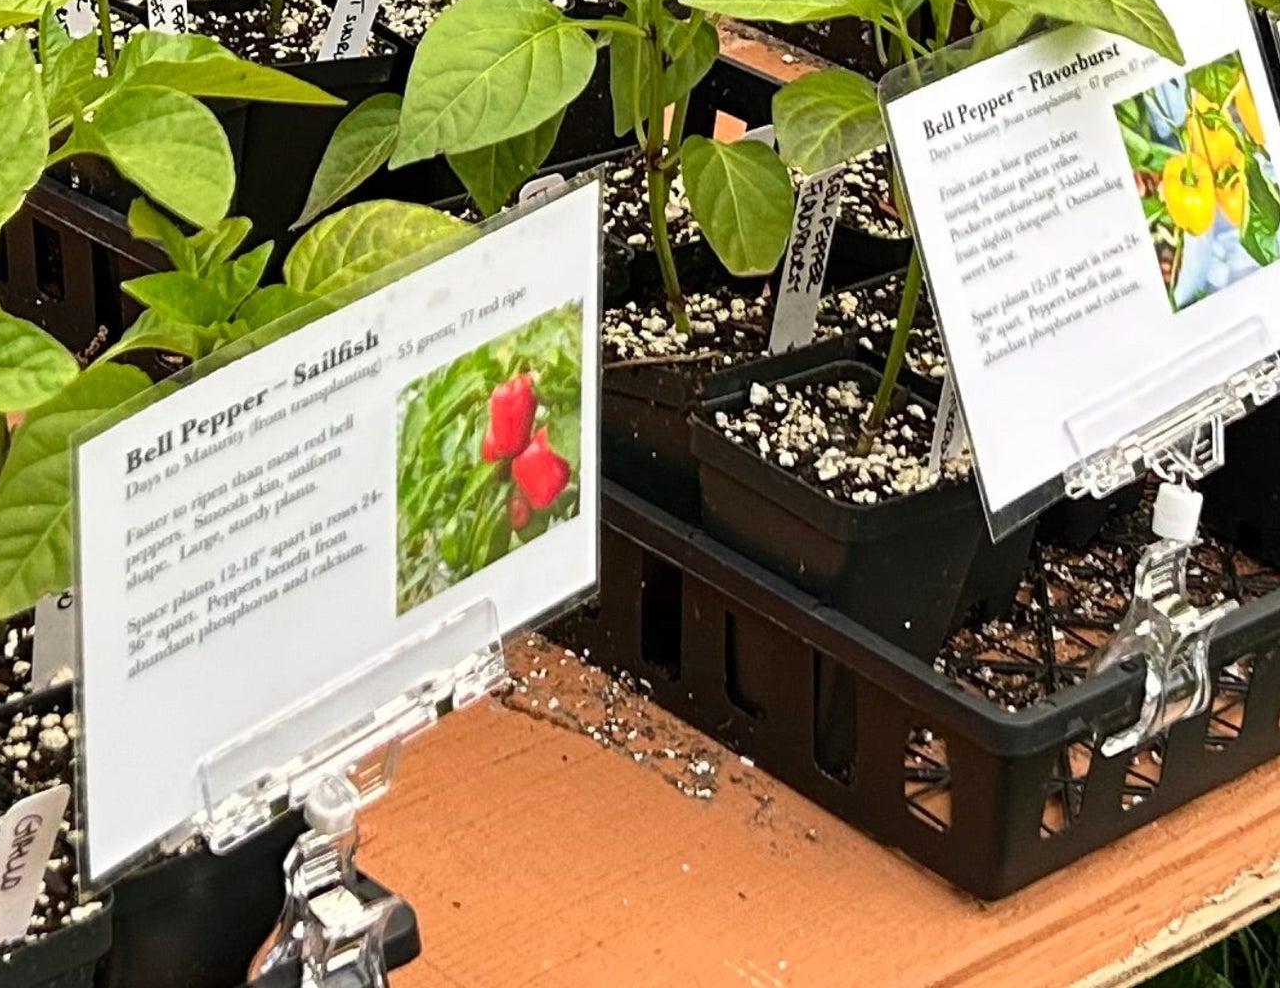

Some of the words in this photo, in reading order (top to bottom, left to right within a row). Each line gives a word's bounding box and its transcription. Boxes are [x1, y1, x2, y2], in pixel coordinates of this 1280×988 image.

[124, 474, 161, 501] Days
[164, 462, 180, 479] to
[183, 430, 244, 469] Maturity
[396, 339, 413, 360] 55
[459, 307, 474, 329] 77
[477, 295, 499, 319] red
[501, 286, 526, 307] ripe
[125, 430, 173, 474] Bell
[180, 388, 268, 444] Pepper
[293, 330, 378, 386] Sailfish
[125, 513, 169, 547] Faster
[171, 504, 187, 520] to
[190, 482, 228, 510] ripen
[231, 465, 263, 489] than
[266, 444, 301, 471] most
[302, 427, 327, 452] red
[328, 413, 354, 439] bell
[125, 531, 184, 570] peppers.
[193, 492, 248, 529] Smooth
[252, 478, 283, 500] skin,
[287, 446, 342, 482] uniform
[125, 559, 171, 591] shape.
[179, 531, 224, 562] Large,
[227, 503, 271, 535] sturdy
[274, 482, 318, 515] plants.
[126, 603, 169, 634] Space
[171, 579, 215, 613] plants
[269, 529, 306, 558] apart
[308, 521, 323, 537] in
[325, 503, 358, 528] rows
[127, 632, 194, 679] abundant
[197, 588, 278, 643] phosphorus
[281, 567, 308, 594] and
[310, 543, 367, 579] calcium.
[156, 611, 197, 639] apart.
[206, 577, 261, 612] Peppers
[264, 547, 310, 581] benefit
[314, 530, 347, 556] from
[0, 812, 44, 892] GIALLO
